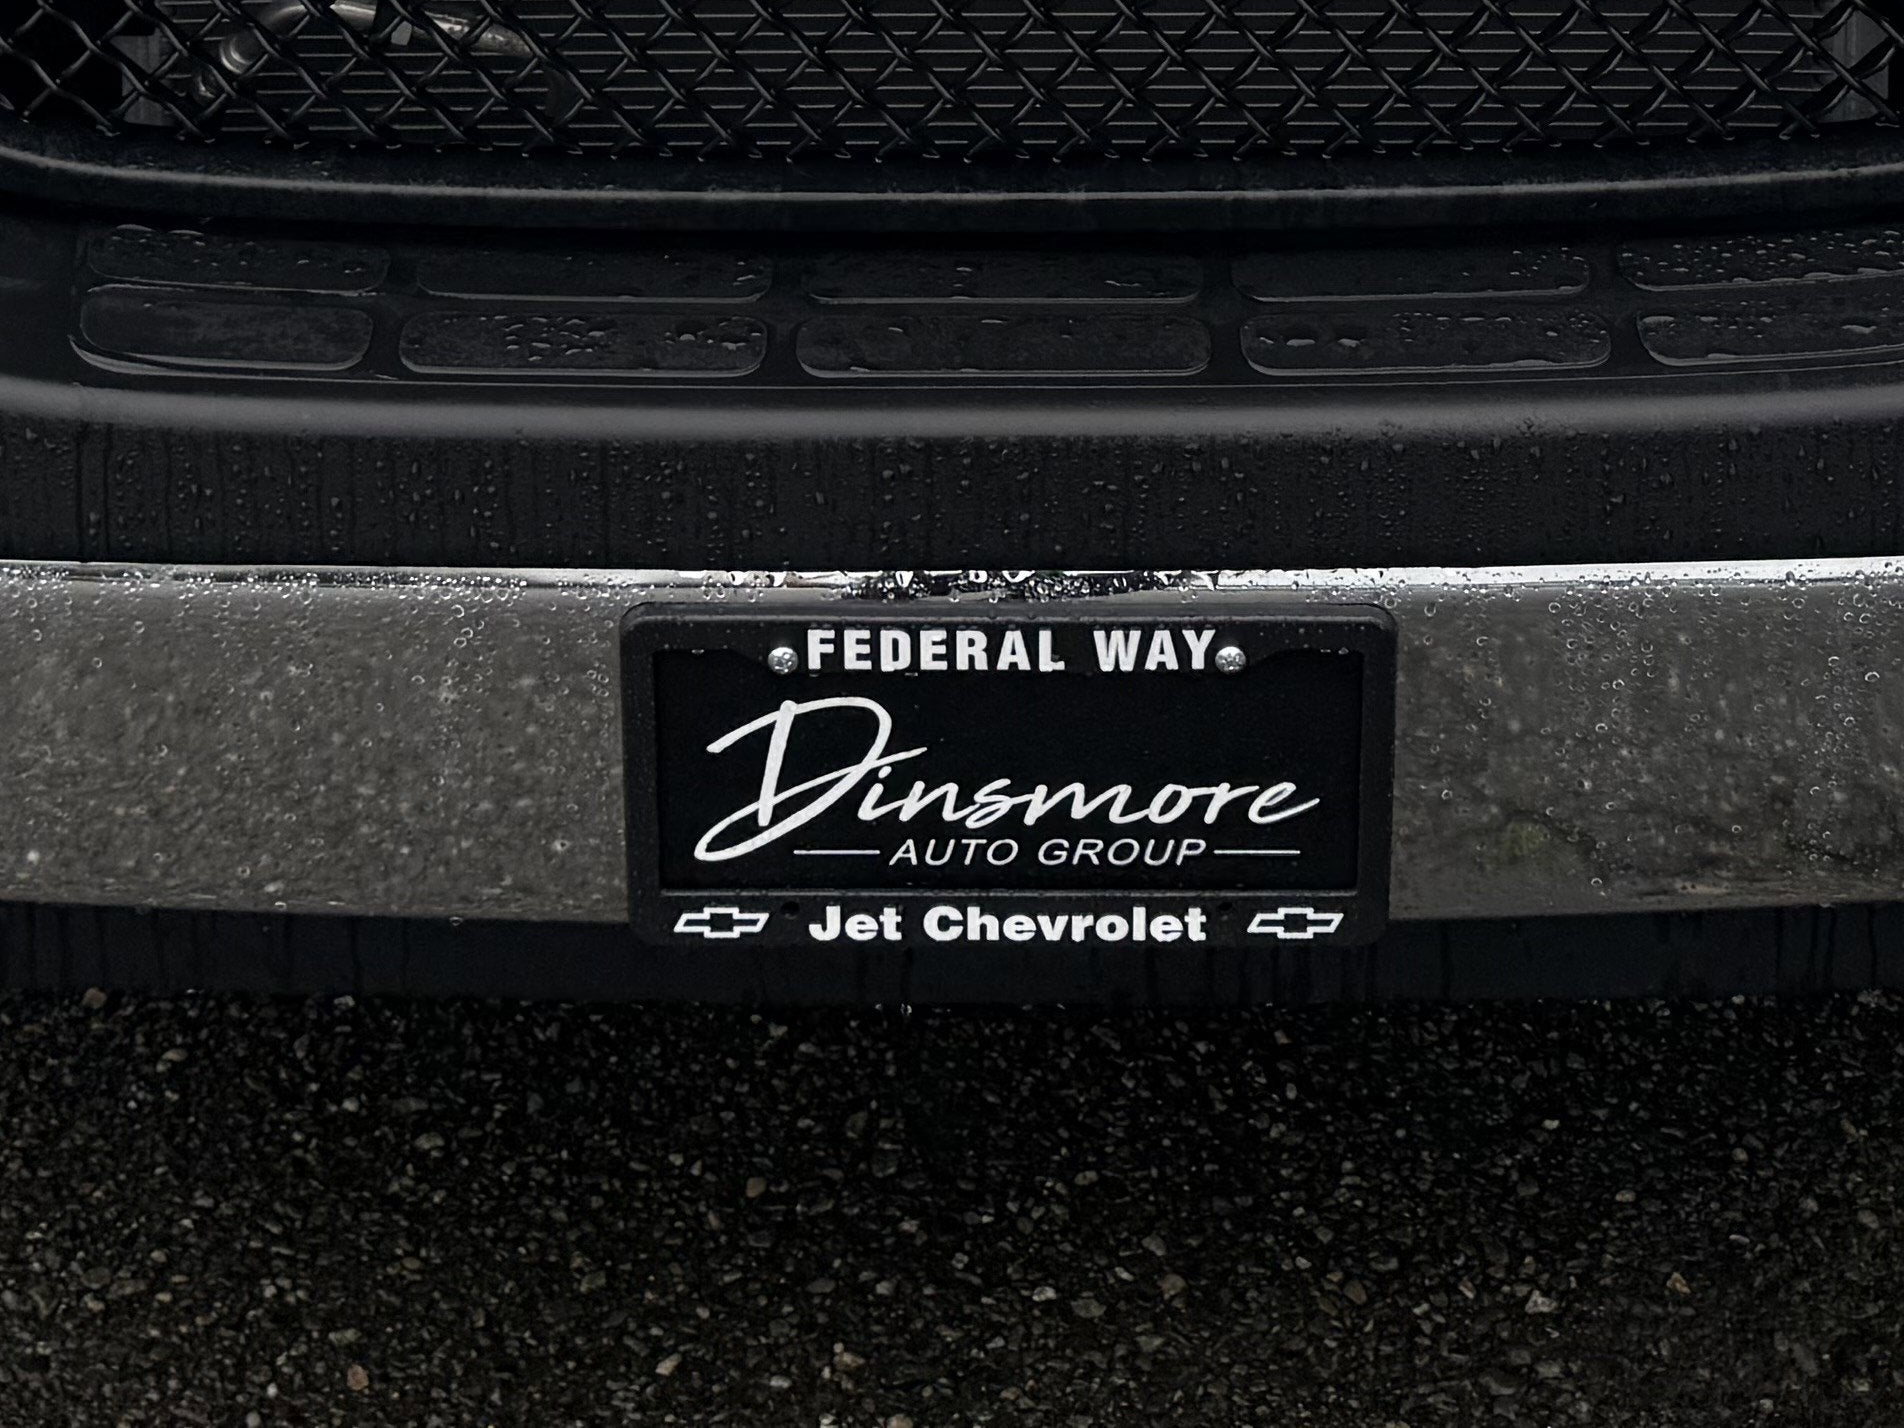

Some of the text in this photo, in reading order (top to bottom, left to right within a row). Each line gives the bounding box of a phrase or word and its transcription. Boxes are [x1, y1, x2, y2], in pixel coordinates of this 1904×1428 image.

[806, 629, 1217, 671] FEDERAL WAY
[694, 696, 1320, 863] Dinsmore
[888, 838, 1207, 867] AUTO GROUP
[808, 905, 1206, 943] Jet Chevrolet
